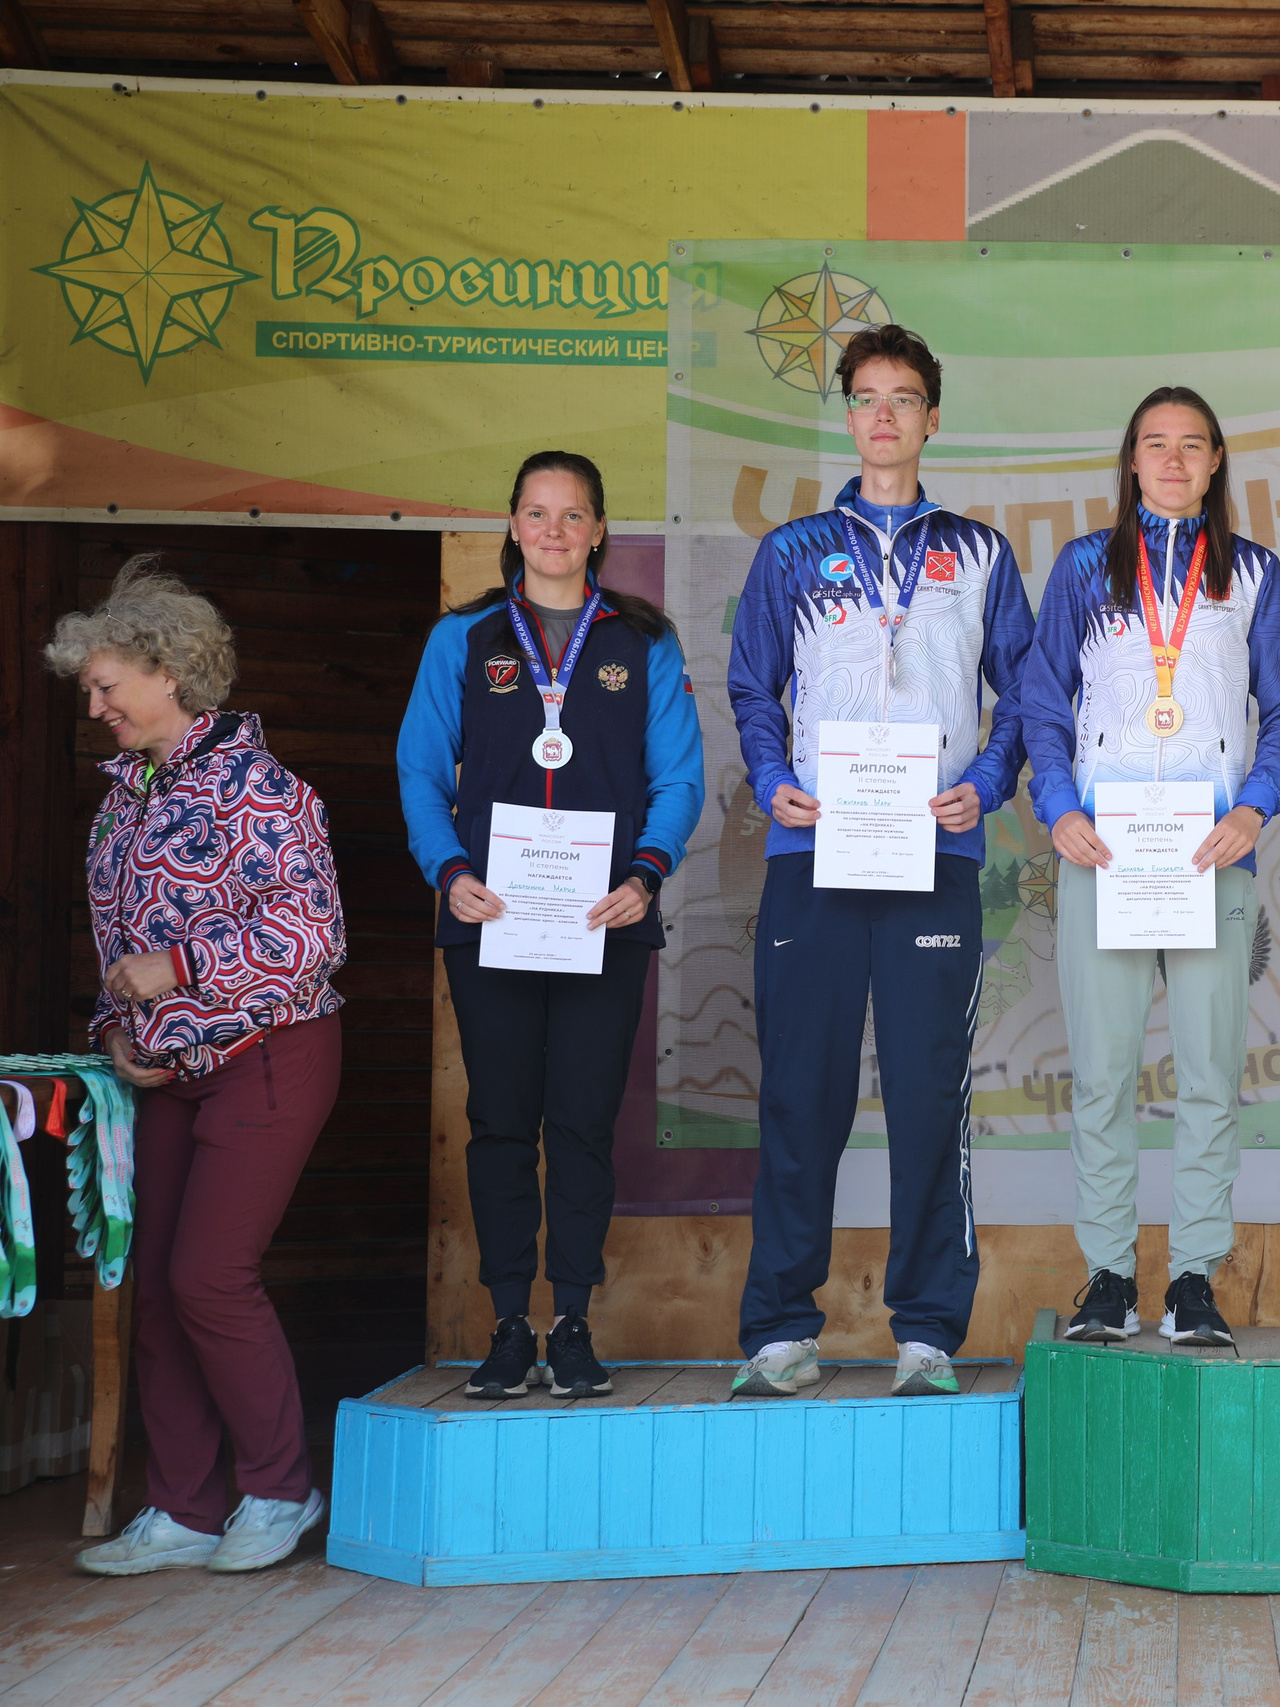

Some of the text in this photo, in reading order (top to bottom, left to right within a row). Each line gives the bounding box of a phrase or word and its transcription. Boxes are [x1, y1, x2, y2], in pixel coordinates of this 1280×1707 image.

[271, 331, 620, 358] СПОРТИВНО-ТУРИСТИЧЕСКИЙ
[853, 546, 874, 596] ЧЕЛЯБИНСКАЯ
[903, 562, 918, 594] ОБЛАСТЬ
[1176, 545, 1205, 633] ЧЕЛЯБИНСКАЯ ОБЛАСТЬ
[824, 614, 837, 622] SFR
[1141, 576, 1157, 632] ЧЕЛЯБИНСКАЯ
[564, 637, 581, 672] ОБЛАСТЬ
[849, 764, 906, 774] ДИПЛОМ
[1127, 823, 1184, 833] ДИПЛОМ
[521, 848, 580, 861] ДИПЛОМ
